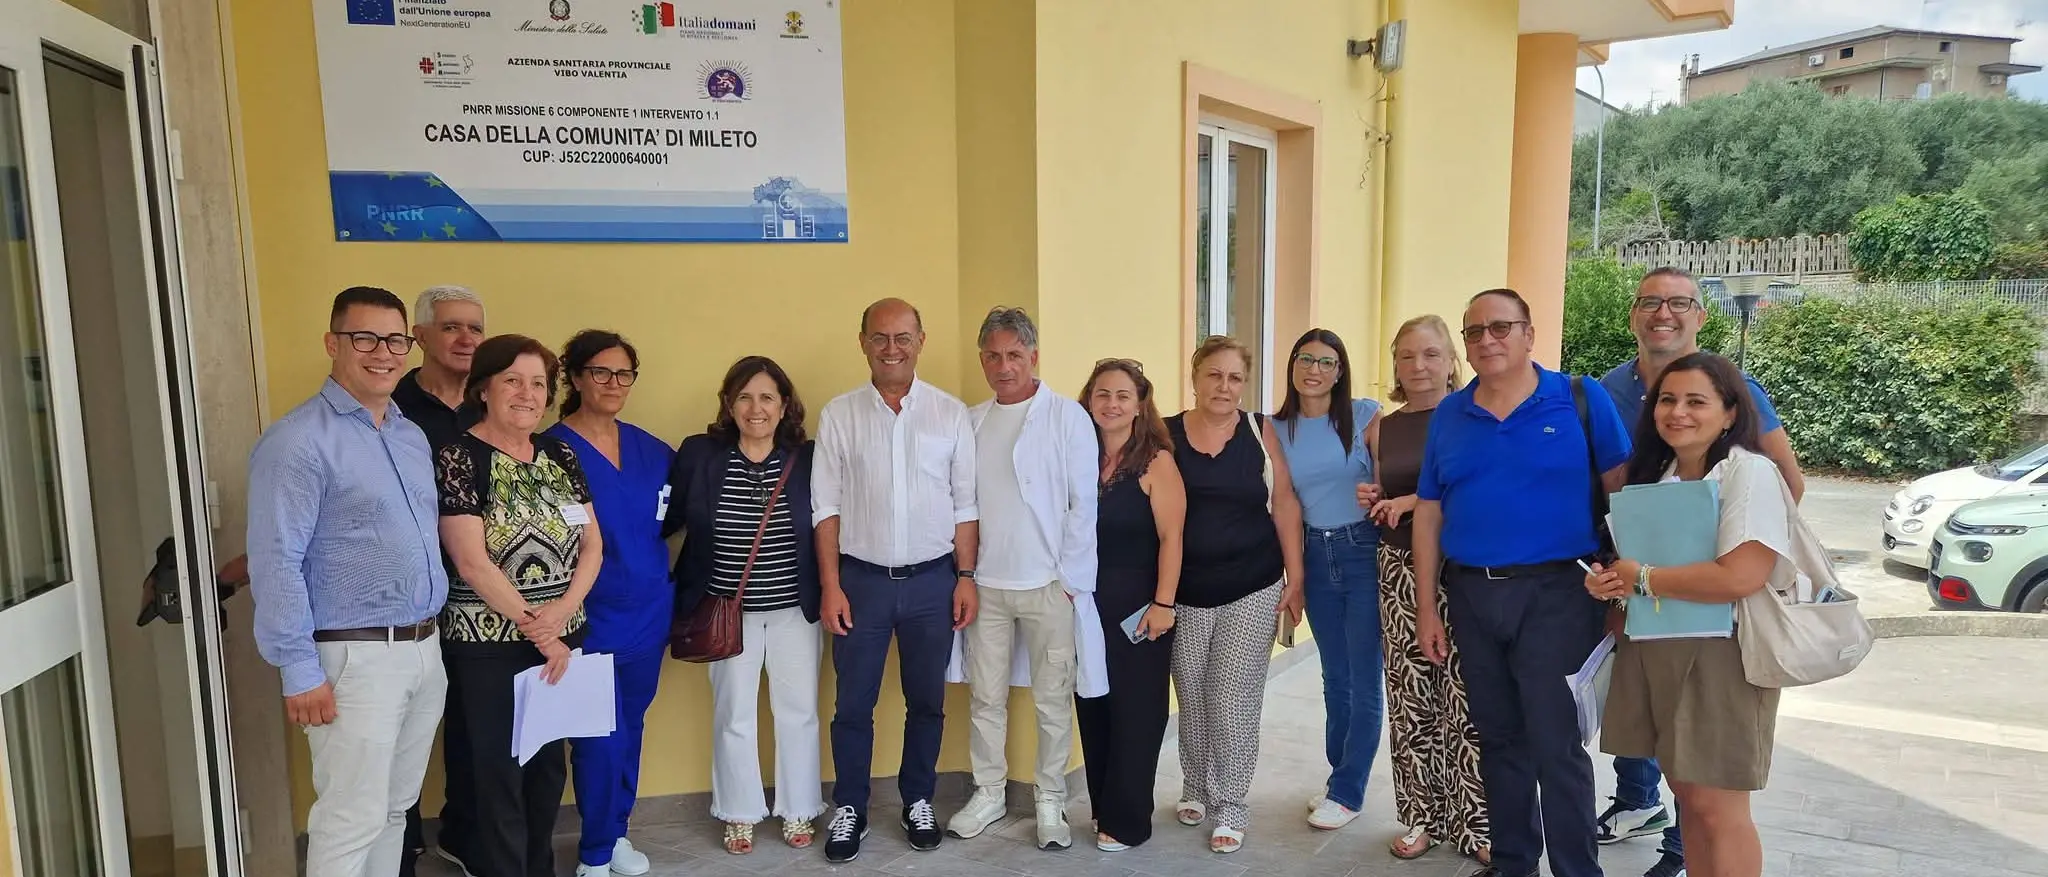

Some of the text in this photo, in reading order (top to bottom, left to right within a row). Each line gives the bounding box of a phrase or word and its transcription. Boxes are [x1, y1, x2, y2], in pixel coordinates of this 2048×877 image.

[399, 7, 491, 18] dall'Unione europea
[400, 19, 471, 29] NextGenerationEU
[679, 16, 756, 31] Italiadomani
[507, 58, 672, 71] AZIENDA SANITARIA PROVINCIALE
[554, 69, 628, 79] VIBO VALENTIA
[462, 104, 720, 121] PNRR MISSIONE 6 COMPONENTE 1 INTERVENTO 1.1
[424, 123, 482, 143] CASA
[485, 124, 552, 144] DELLA
[665, 128, 684, 147] DI
[688, 129, 758, 148] MILETO
[522, 149, 669, 165] CUP: J52C22000640001
[366, 203, 426, 221] PNRR
